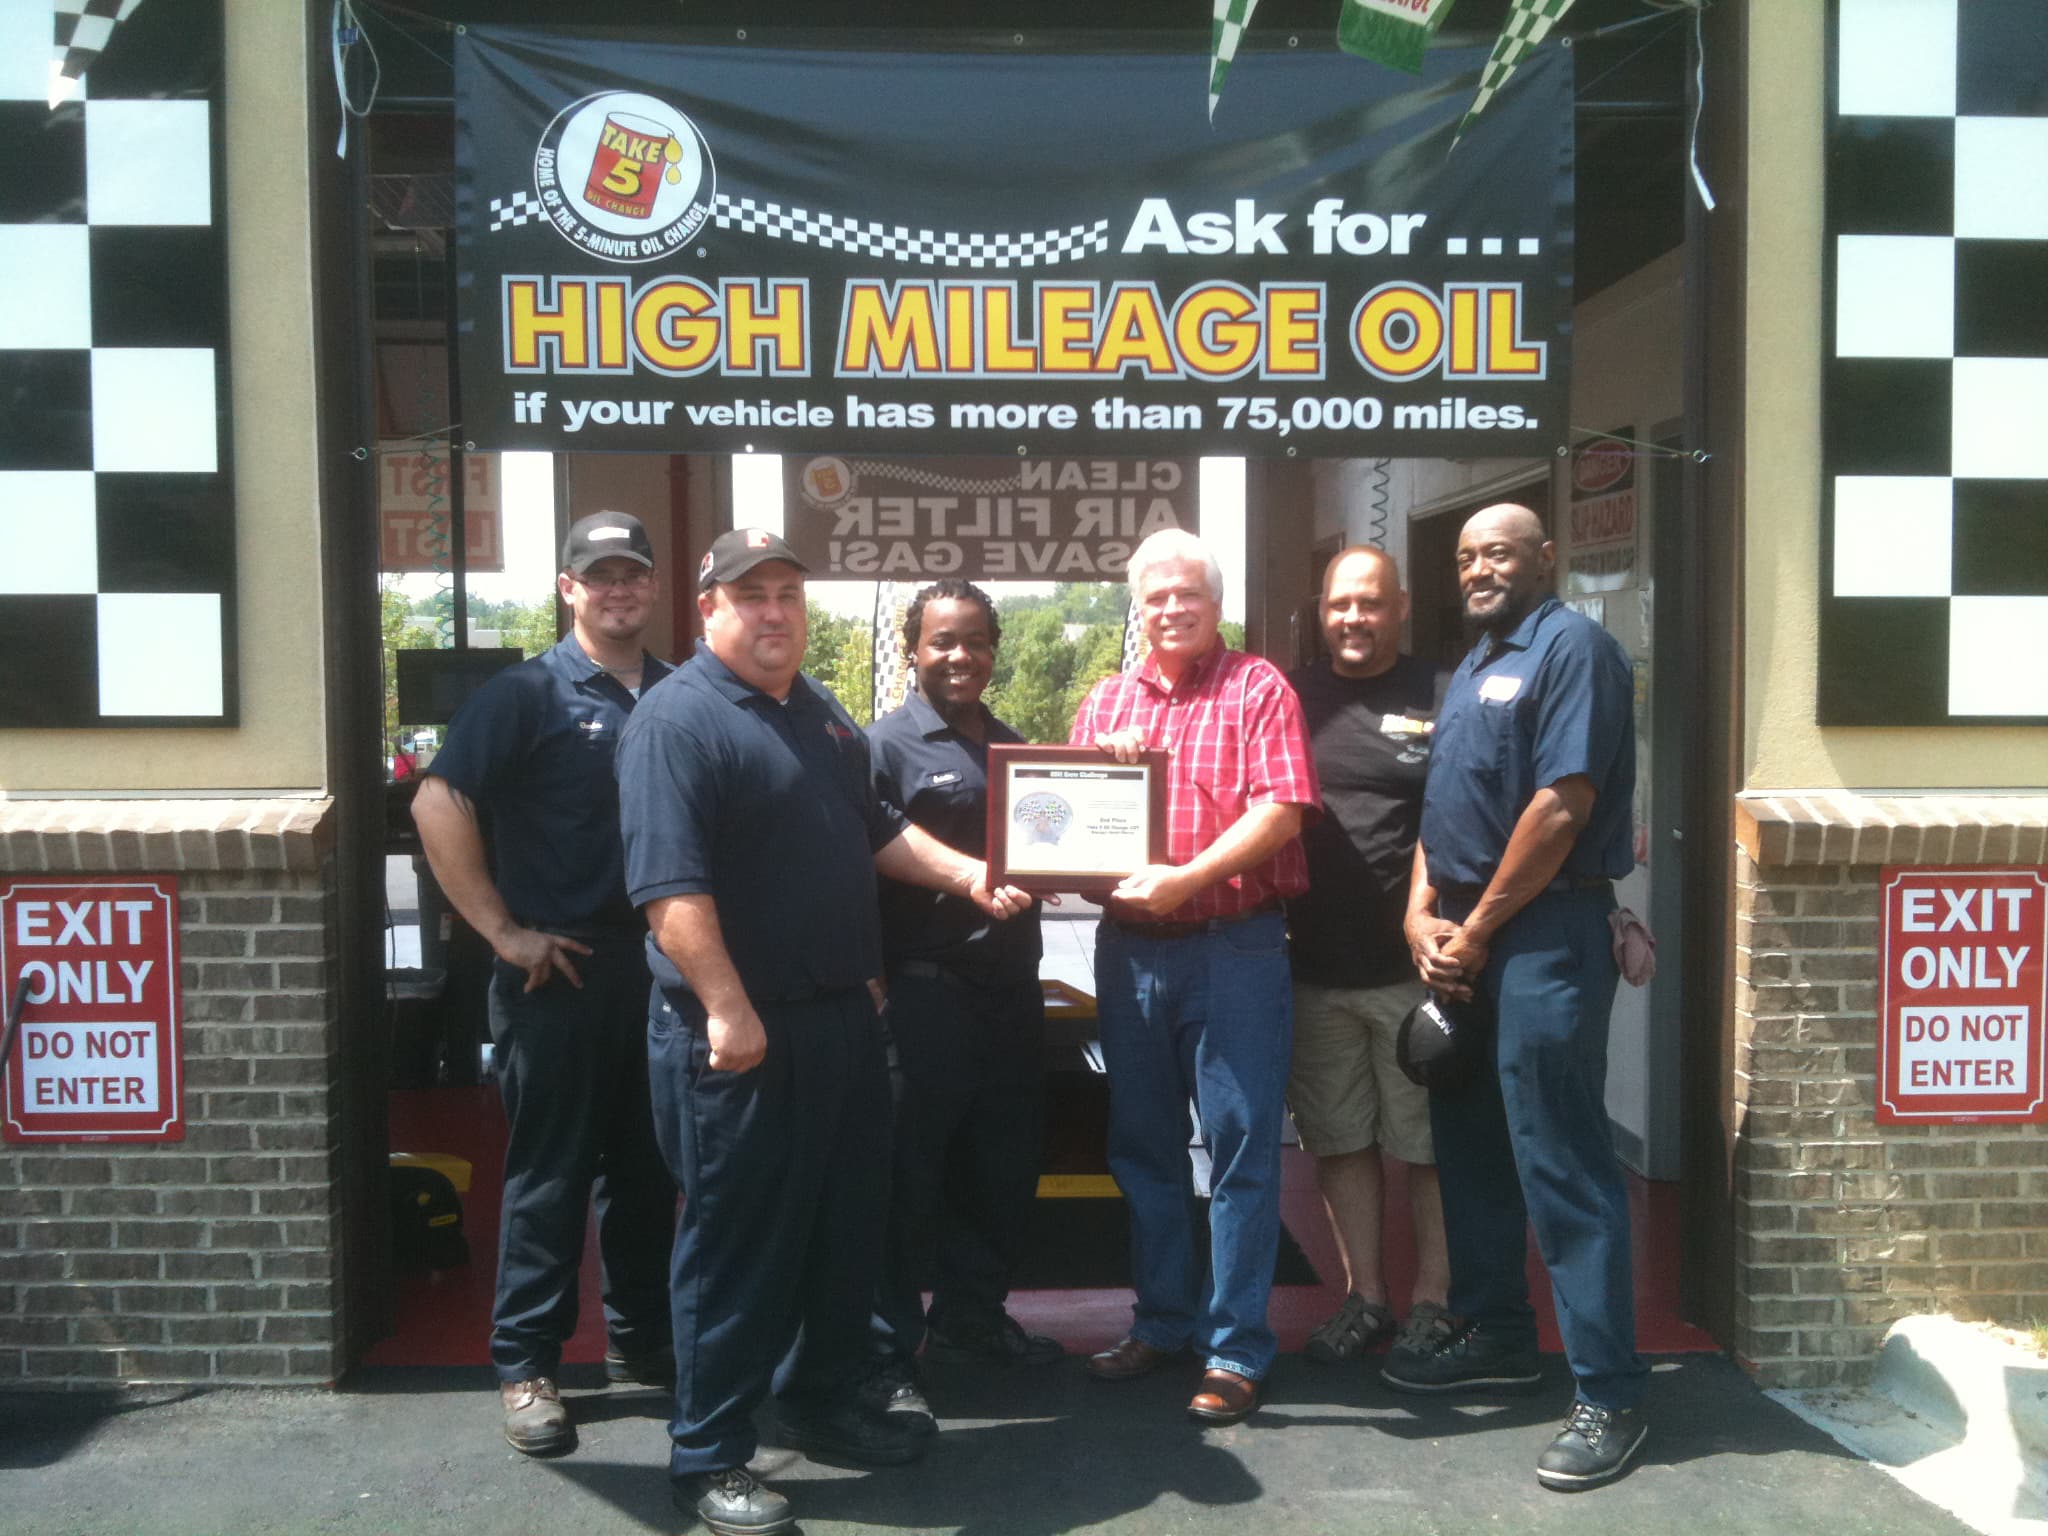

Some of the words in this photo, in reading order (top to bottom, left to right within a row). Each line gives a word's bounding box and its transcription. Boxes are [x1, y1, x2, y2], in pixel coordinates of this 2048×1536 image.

[601, 123, 663, 163] TAKE
[538, 147, 555, 187] HOME
[602, 158, 643, 196] 5
[543, 190, 562, 206] OF
[587, 190, 601, 204] OIL
[606, 199, 646, 217] CHANGE
[553, 206, 577, 232] THE
[664, 202, 708, 246] CHANGE
[1121, 199, 1288, 255] Ask
[574, 226, 637, 257] 5-MINUTE
[641, 237, 665, 252] OIL
[502, 275, 811, 377] HIGH
[834, 279, 1326, 382] MILEAGE
[1350, 280, 1547, 382] OIL
[514, 392, 547, 424] if
[562, 397, 674, 432] your
[686, 397, 834, 428] vehicle
[846, 396, 935, 428] has
[951, 402, 1077, 430] more
[1092, 397, 1201, 430] than
[1217, 396, 1382, 436] 75,000
[1394, 397, 1538, 430] miles.
[16, 901, 153, 945] EXIT
[1902, 888, 2032, 932] EXIT
[19, 961, 154, 1004] ONLY
[1901, 946, 2031, 989] ONLY
[28, 1031, 73, 1059] DO
[86, 1031, 150, 1059] NOT
[1906, 1015, 1950, 1042] DO
[1961, 1015, 2023, 1042] NOT
[36, 1077, 146, 1105] ENTER
[1911, 1059, 2015, 1087] ENTER
